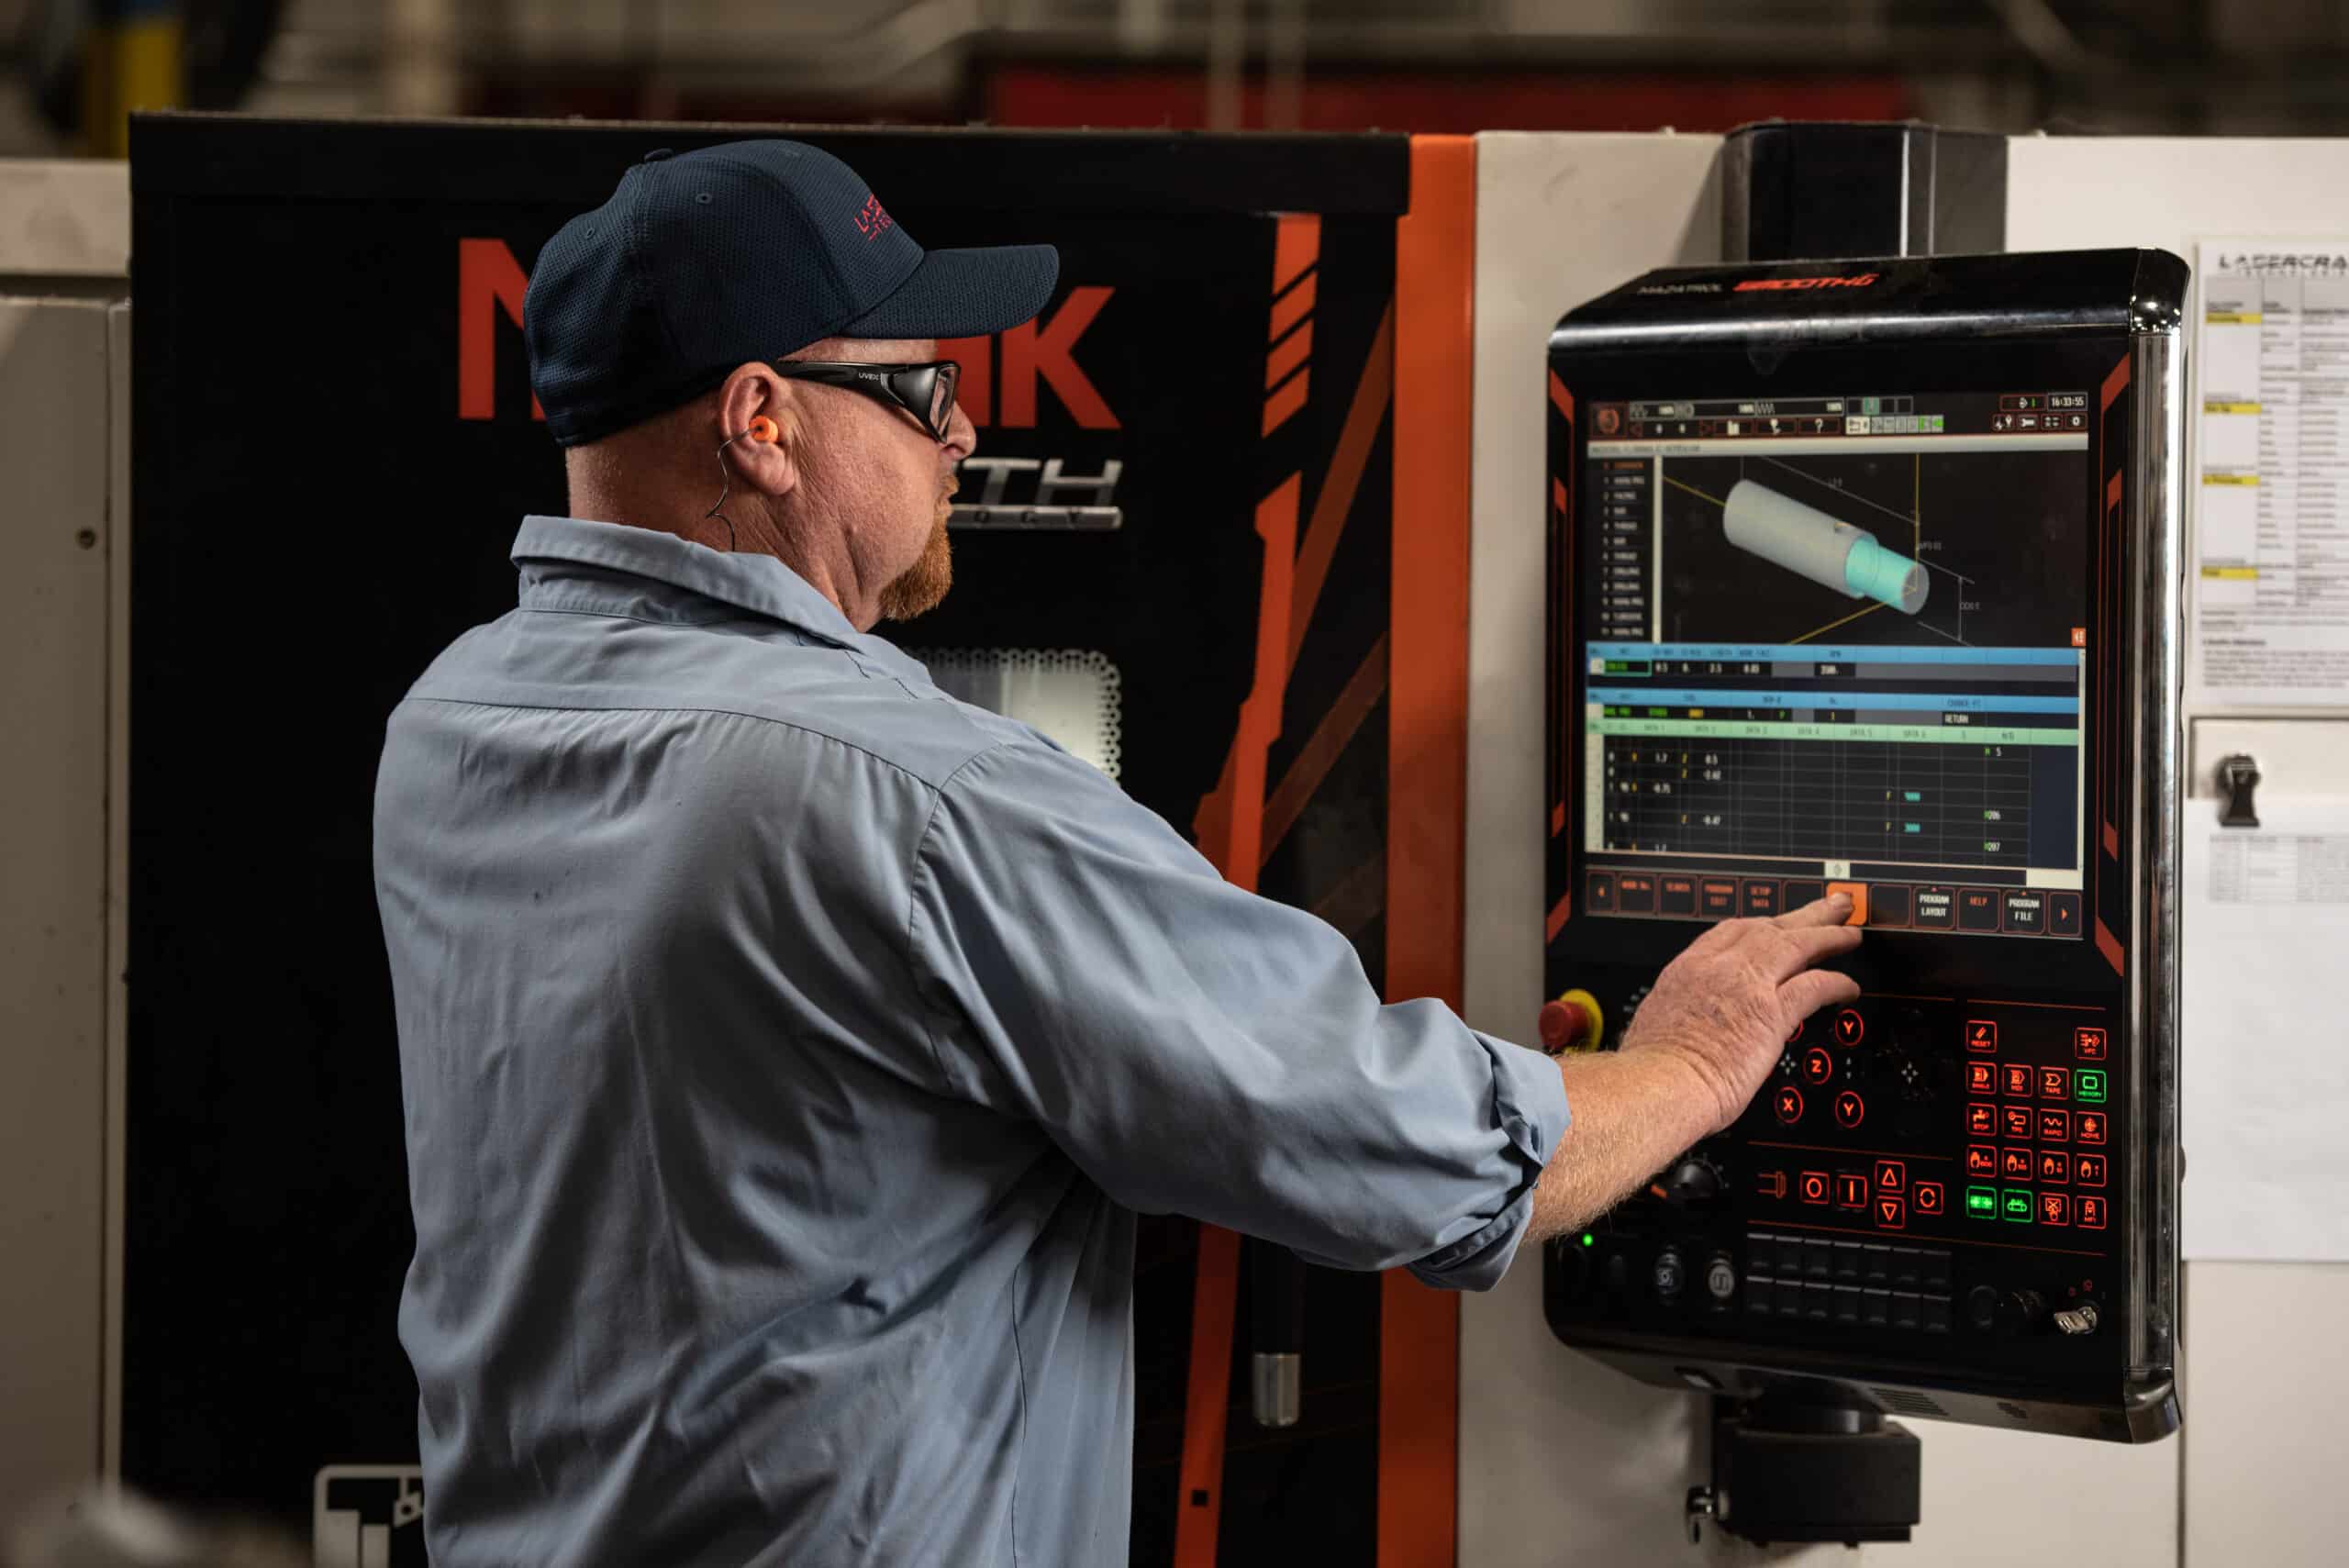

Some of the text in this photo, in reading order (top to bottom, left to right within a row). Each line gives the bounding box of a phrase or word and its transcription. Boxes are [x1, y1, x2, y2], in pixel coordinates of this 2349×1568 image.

[2051, 396, 2085, 407] 16:33:55
[1919, 894, 1950, 905] PROGRAM
[1969, 895, 1987, 906] HELP
[2009, 898, 2041, 908] PROGRAM
[1920, 907, 1946, 917] LAYOUT
[2015, 911, 2034, 921] FILE
[1843, 1020, 1854, 1035] Y
[1811, 1059, 1821, 1073] Z
[1783, 1097, 1794, 1112] X
[1843, 1103, 1854, 1117] Y
